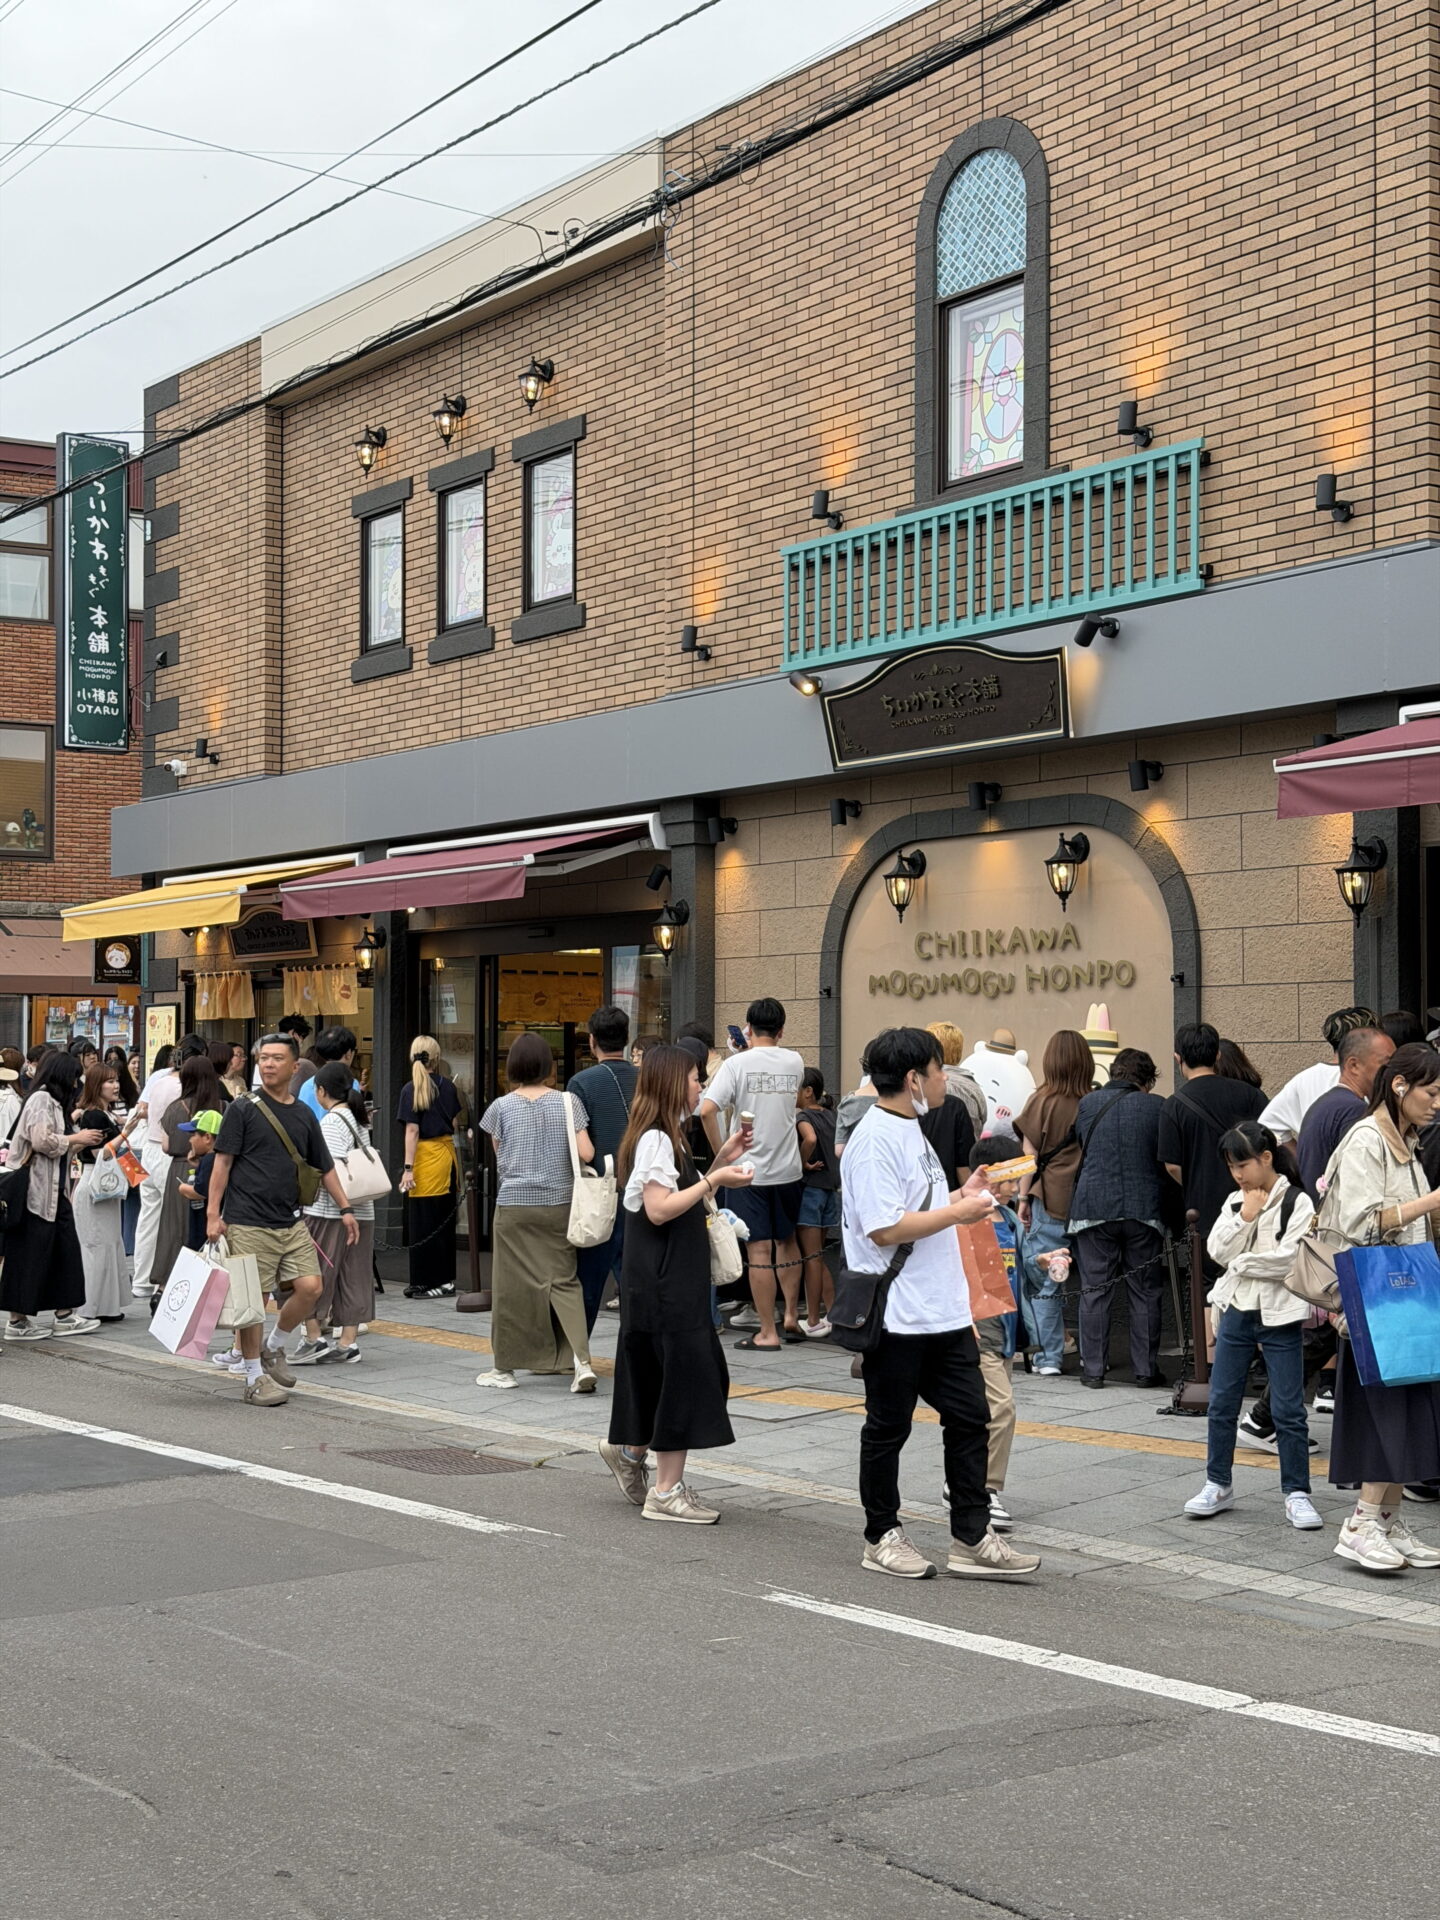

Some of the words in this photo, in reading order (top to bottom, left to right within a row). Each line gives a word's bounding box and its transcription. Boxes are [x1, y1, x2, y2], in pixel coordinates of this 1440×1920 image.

[79, 658, 117, 667] CHIIKAWA
[79, 665, 117, 675] MOGUMOGU
[77, 687, 118, 704] 小樽店
[77, 704, 119, 715] OTARU
[914, 922, 1081, 960] CHIIKAWA
[868, 967, 1016, 1000] MOGUMOGU
[1025, 959, 1137, 992] HONPO
